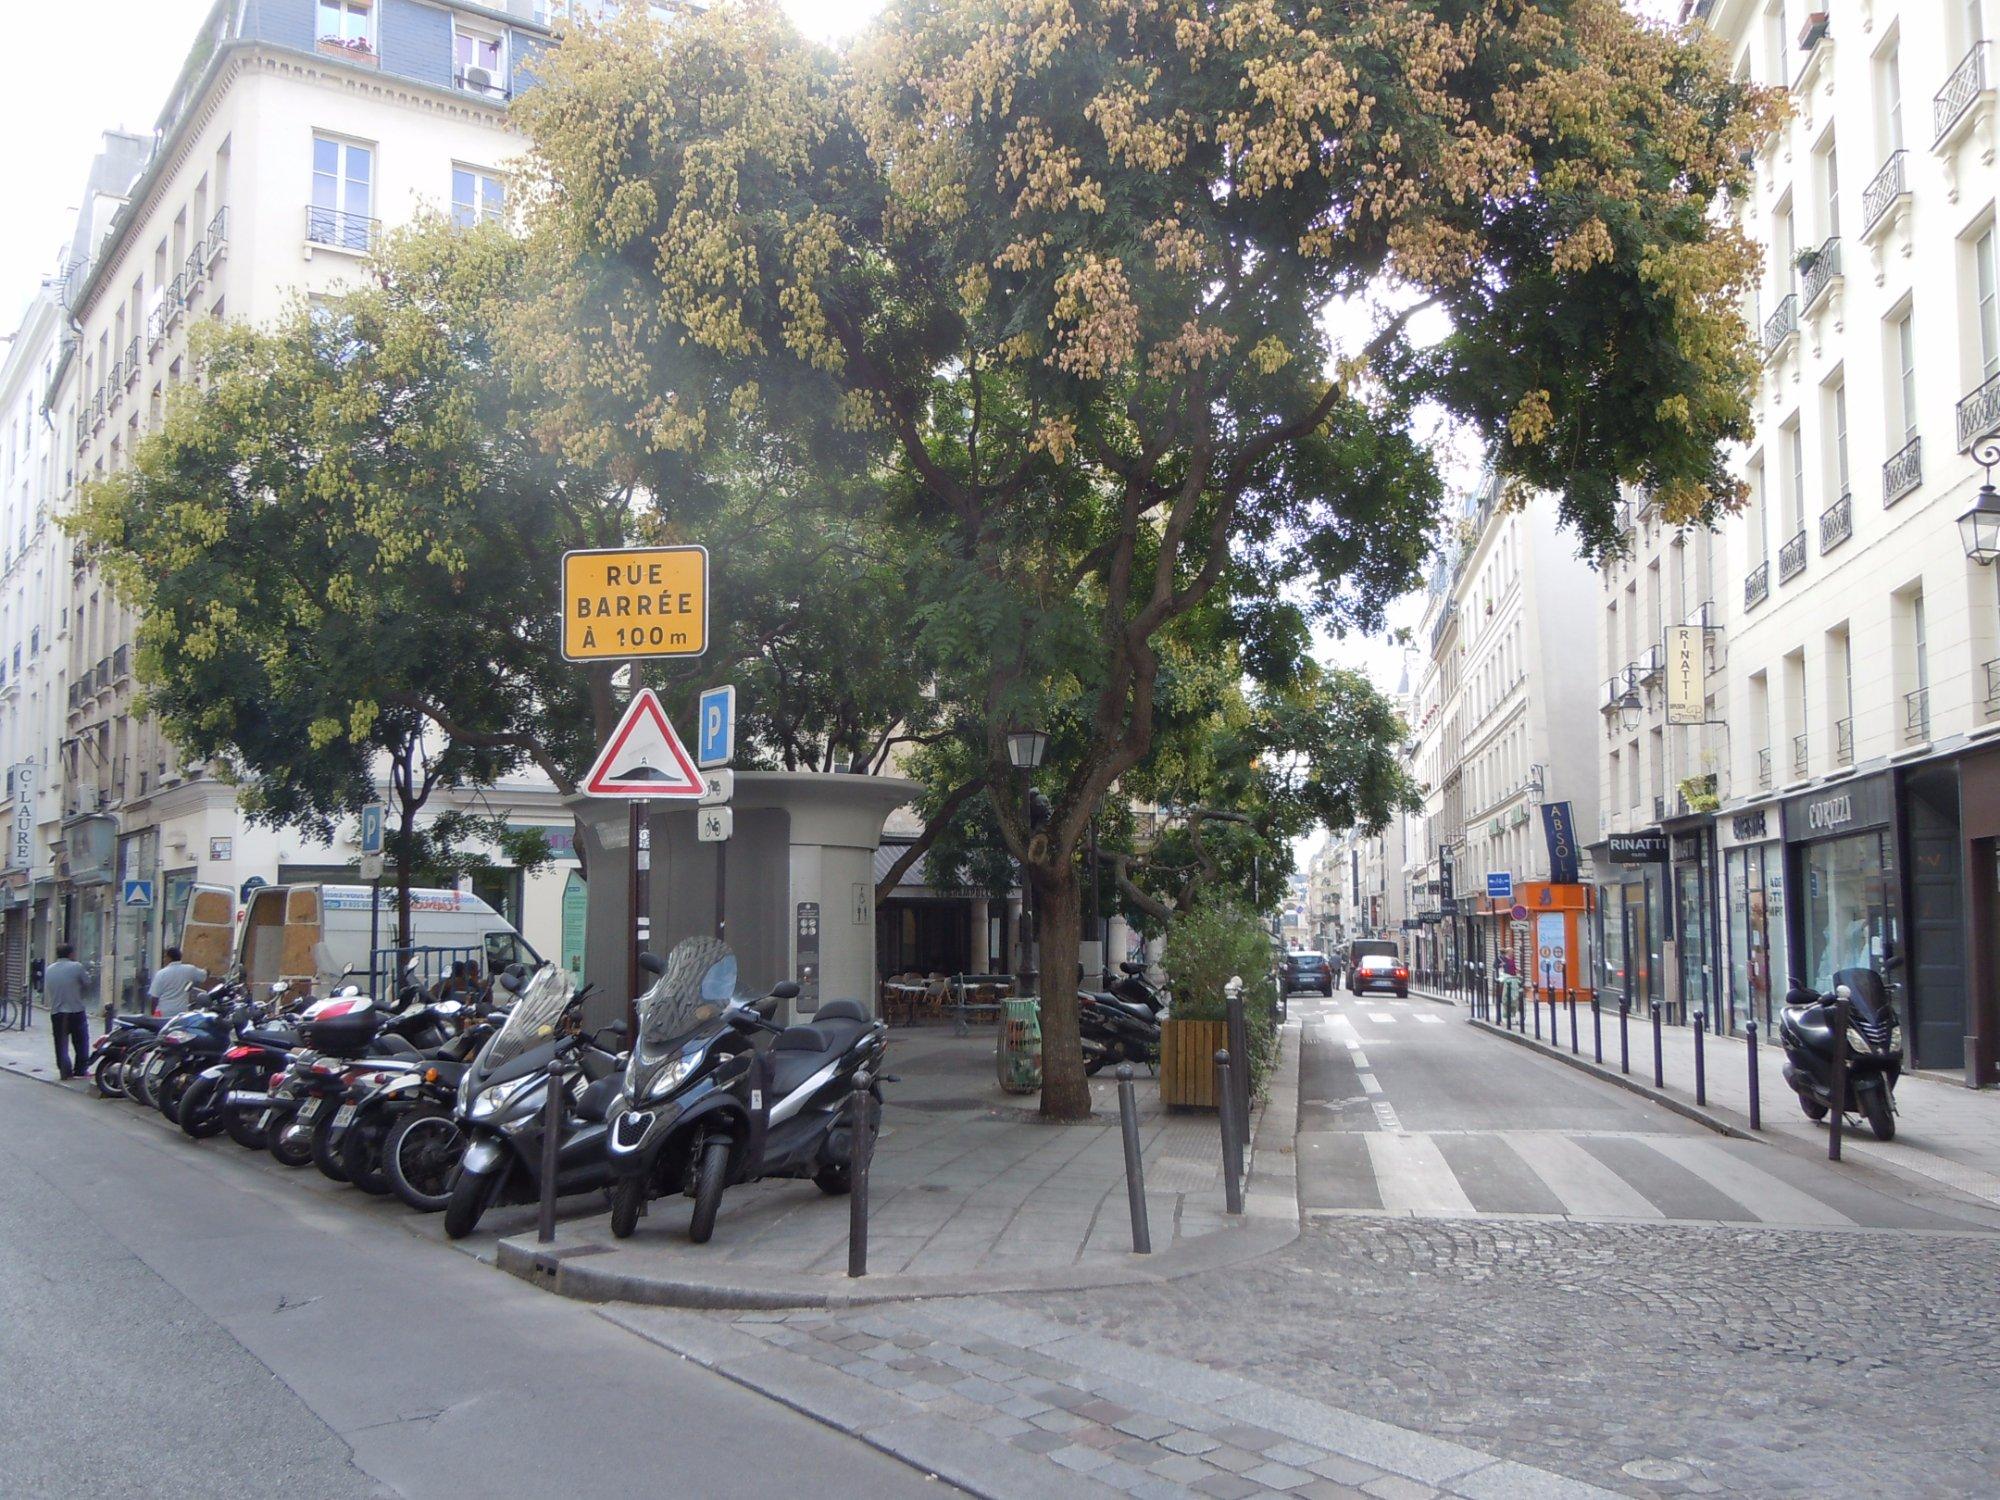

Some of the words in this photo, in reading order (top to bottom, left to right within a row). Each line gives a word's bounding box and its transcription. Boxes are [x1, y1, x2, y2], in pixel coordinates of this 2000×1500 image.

[606, 564, 662, 586] RUE
[577, 590, 692, 618] BARRÉE
[582, 626, 596, 648] À
[1680, 630, 1690, 700] RINATTI
[707, 706, 722, 750] P
[1808, 795, 1853, 830] CORIZZI
[367, 814, 377, 844] P
[1610, 838, 1667, 850] RINATTI
